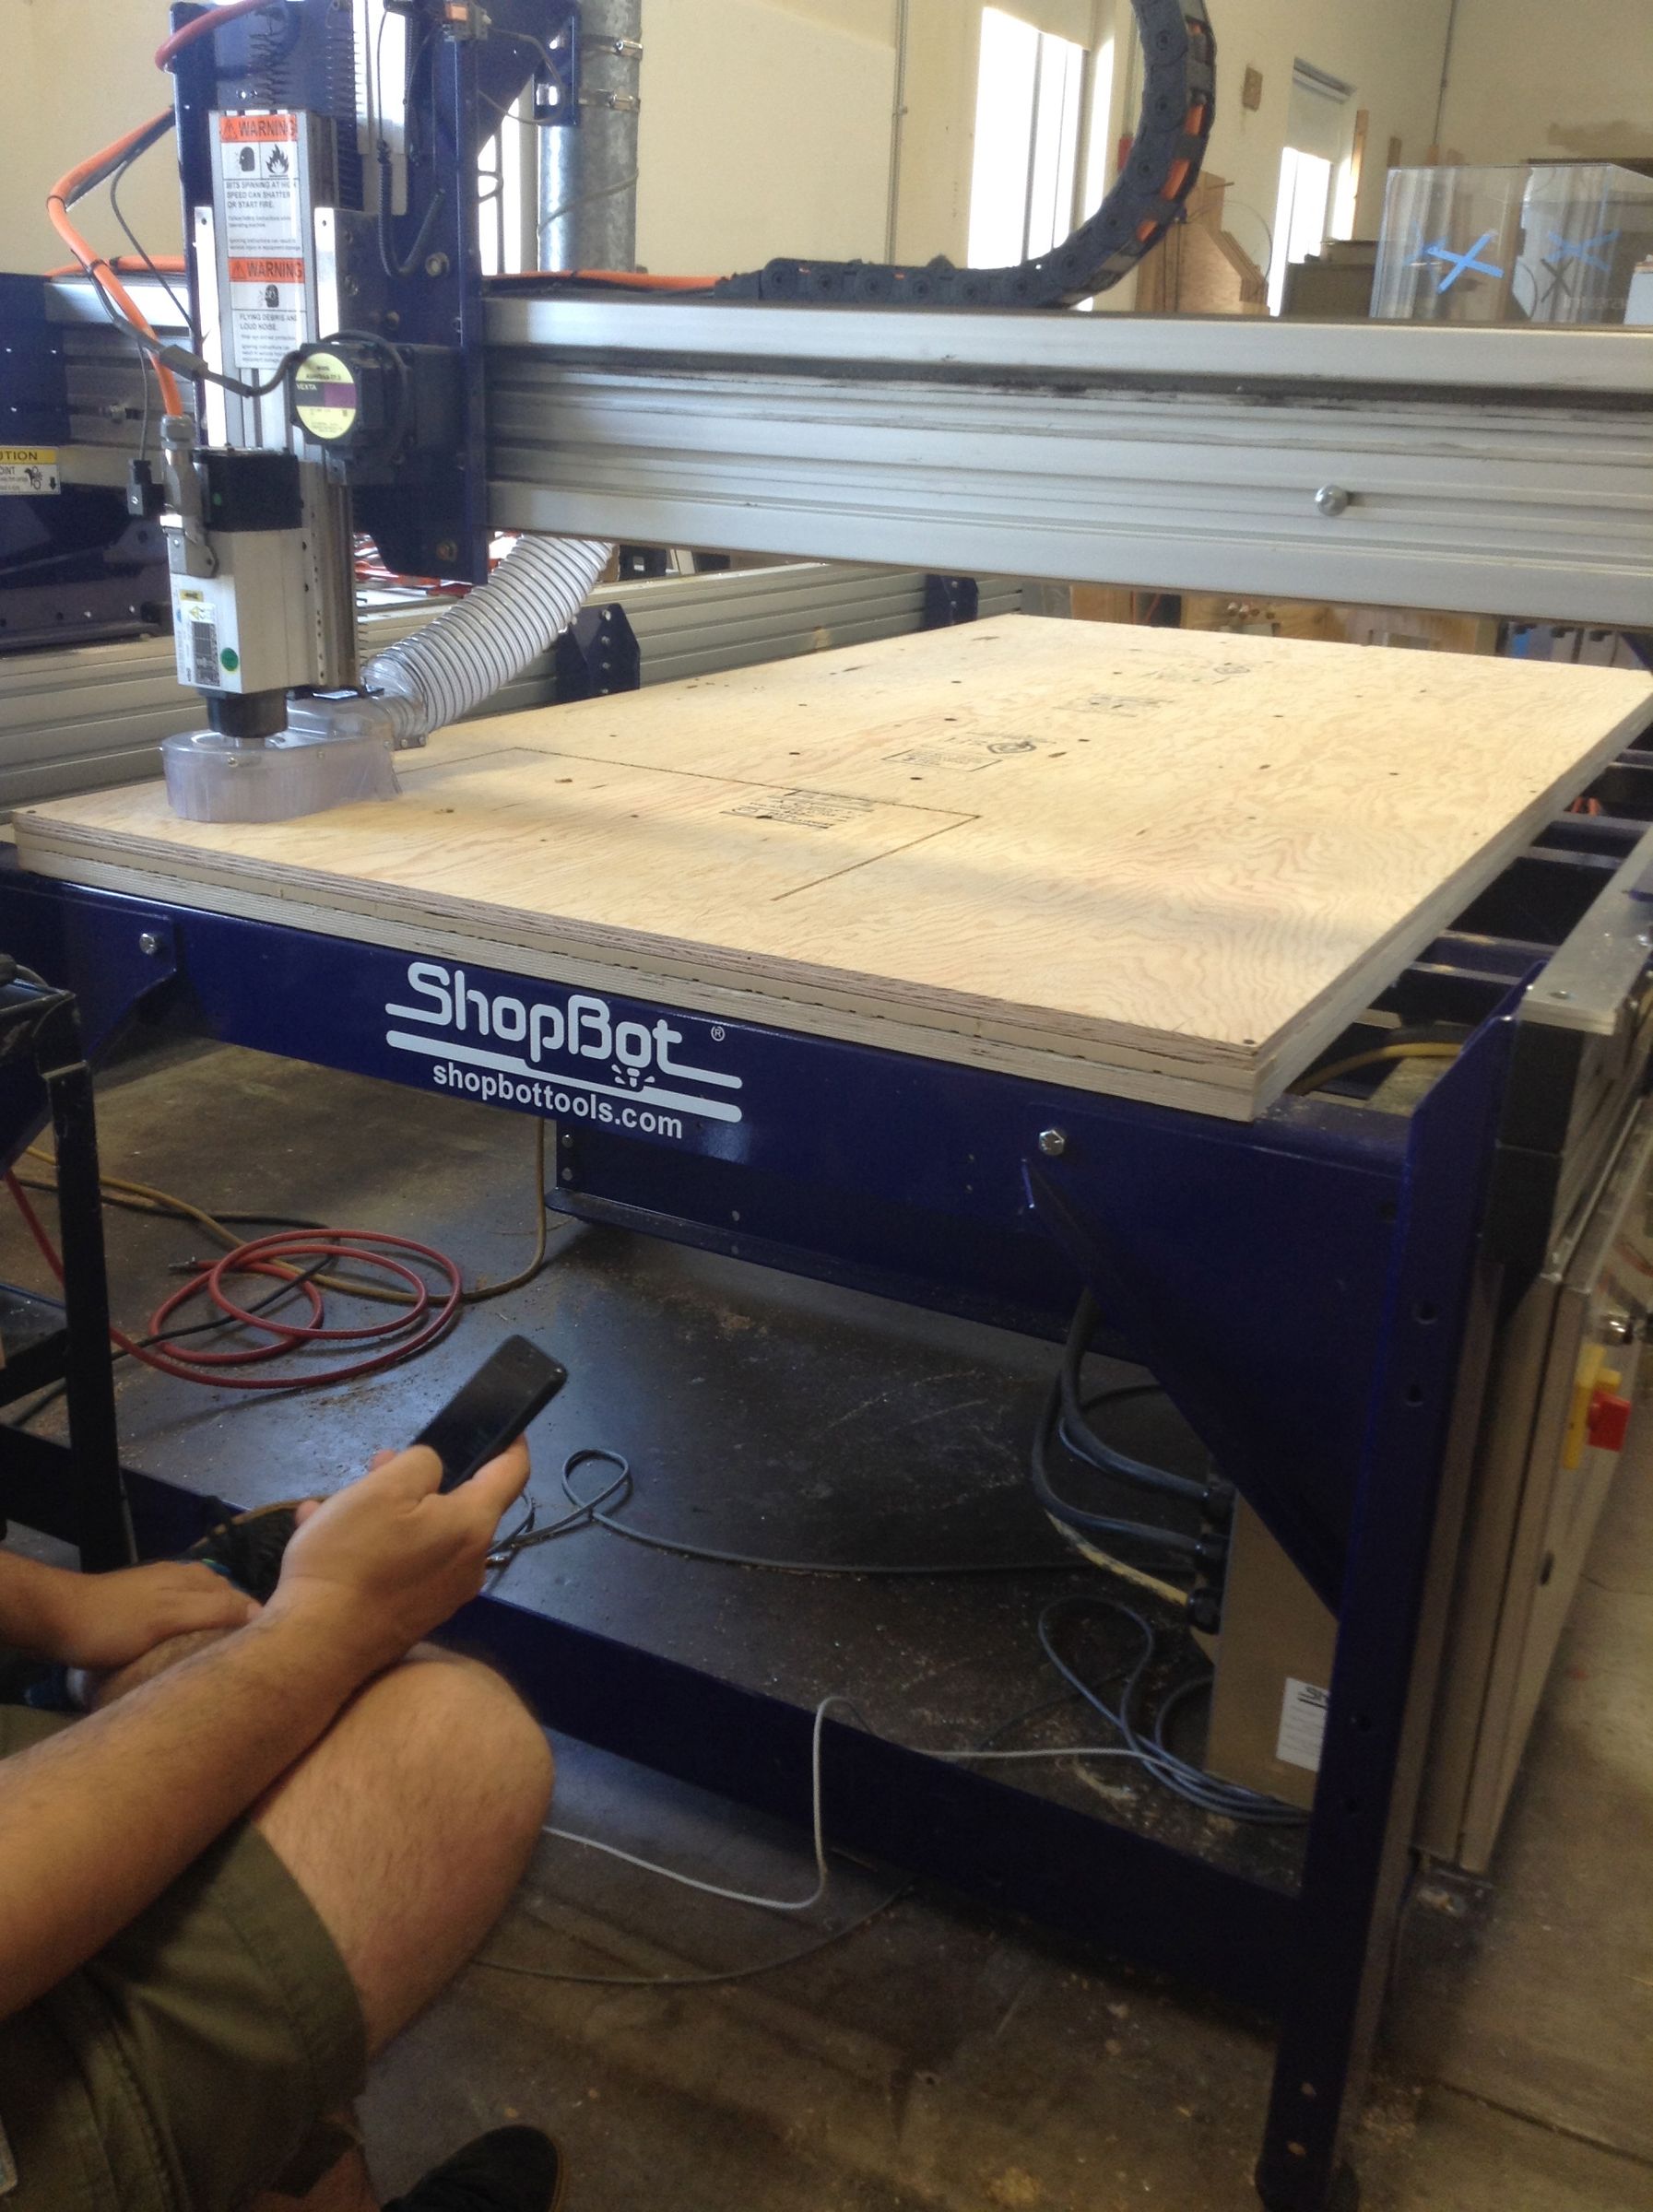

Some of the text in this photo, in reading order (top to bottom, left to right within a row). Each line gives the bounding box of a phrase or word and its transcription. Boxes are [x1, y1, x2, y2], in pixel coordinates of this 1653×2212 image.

[247, 261, 302, 278] WARNING
[385, 961, 743, 1089] ShopBot
[432, 1063, 682, 1139] shopbottools.com
